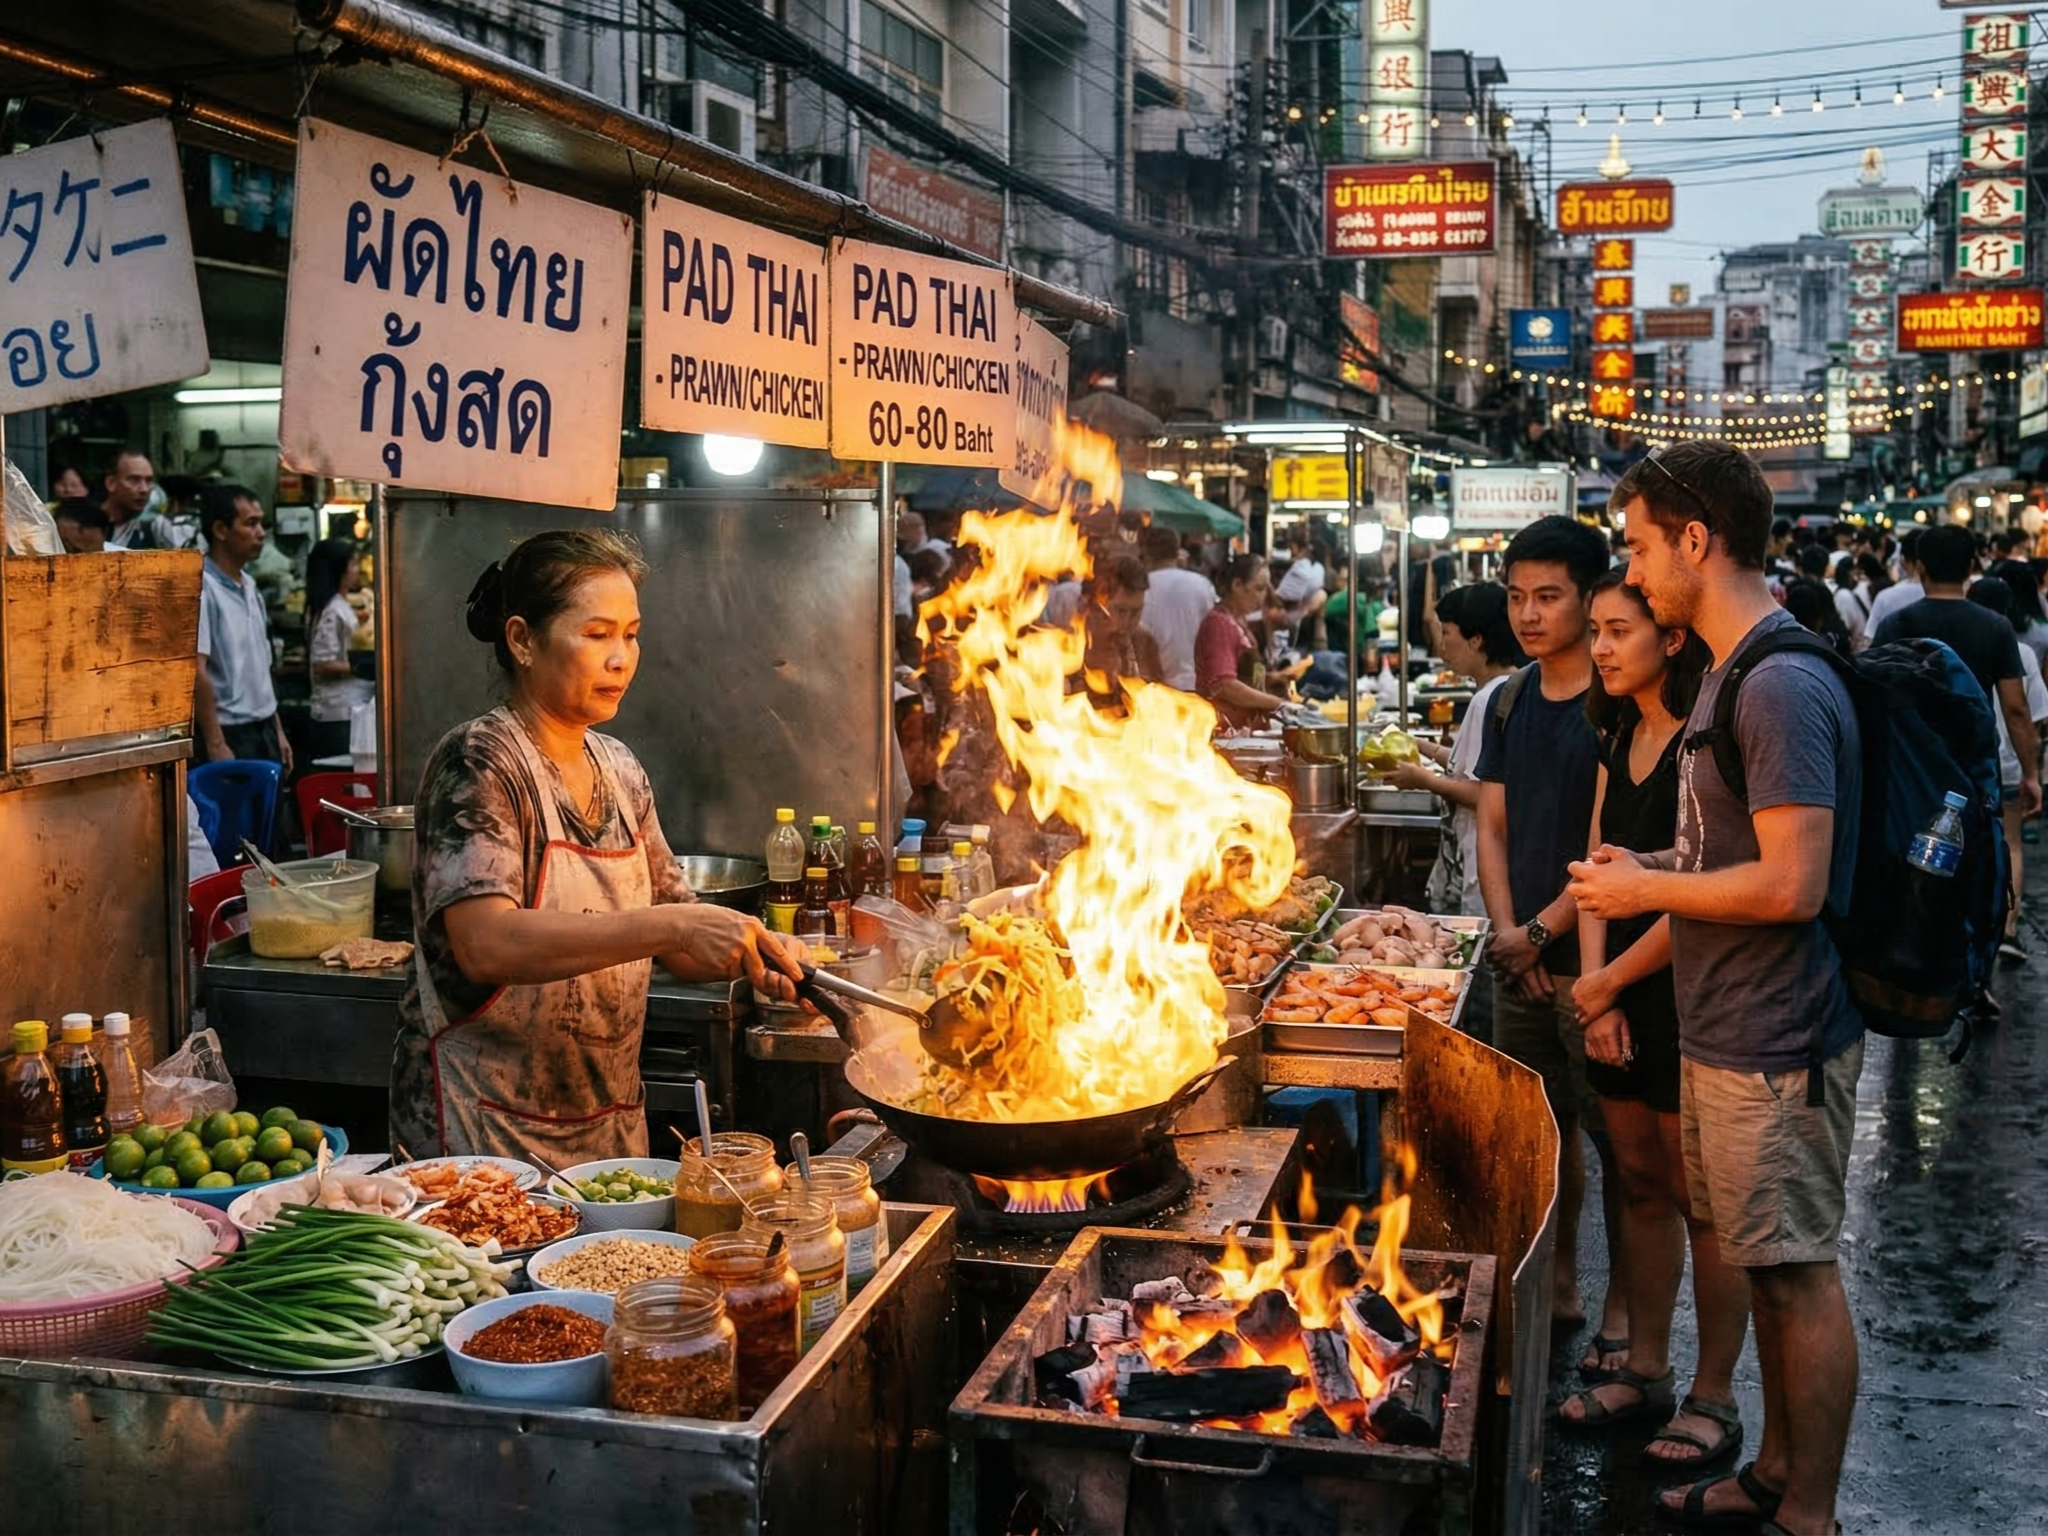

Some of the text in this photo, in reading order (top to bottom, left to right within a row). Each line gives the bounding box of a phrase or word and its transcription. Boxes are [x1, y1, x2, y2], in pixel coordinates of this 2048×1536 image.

[344, 162, 584, 333] ผัดไทย
[662, 229, 818, 346] PAD THAI
[853, 263, 996, 343] PAD THAI
[360, 311, 552, 478] กุ้งสด
[671, 353, 823, 420] PRAWN/CHICKEN
[853, 342, 1010, 395] PRAWN/CHICKEN
[869, 400, 994, 453] 60-80 Baht
